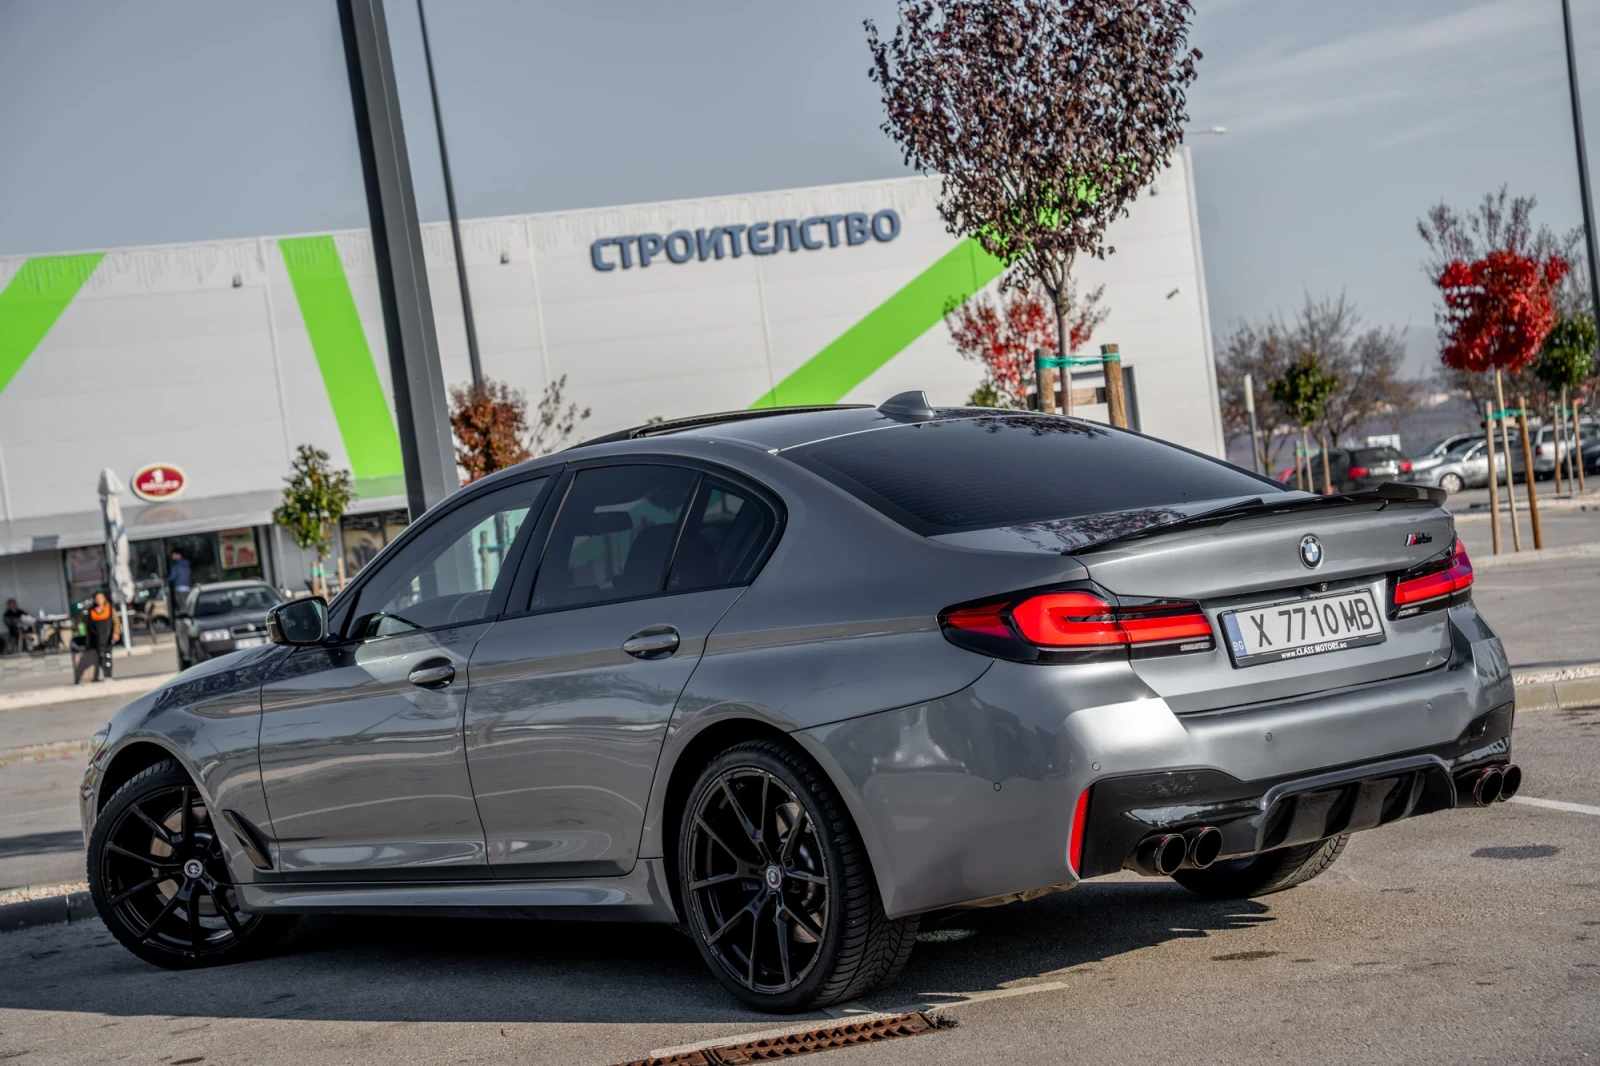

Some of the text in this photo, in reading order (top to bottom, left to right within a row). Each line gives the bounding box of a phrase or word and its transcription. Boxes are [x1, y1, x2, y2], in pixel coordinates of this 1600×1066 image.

[590, 208, 901, 272] СТРОИТЕЛСТВО
[1232, 640, 1245, 652] BG
[1250, 598, 1374, 648] X 7710 MB
